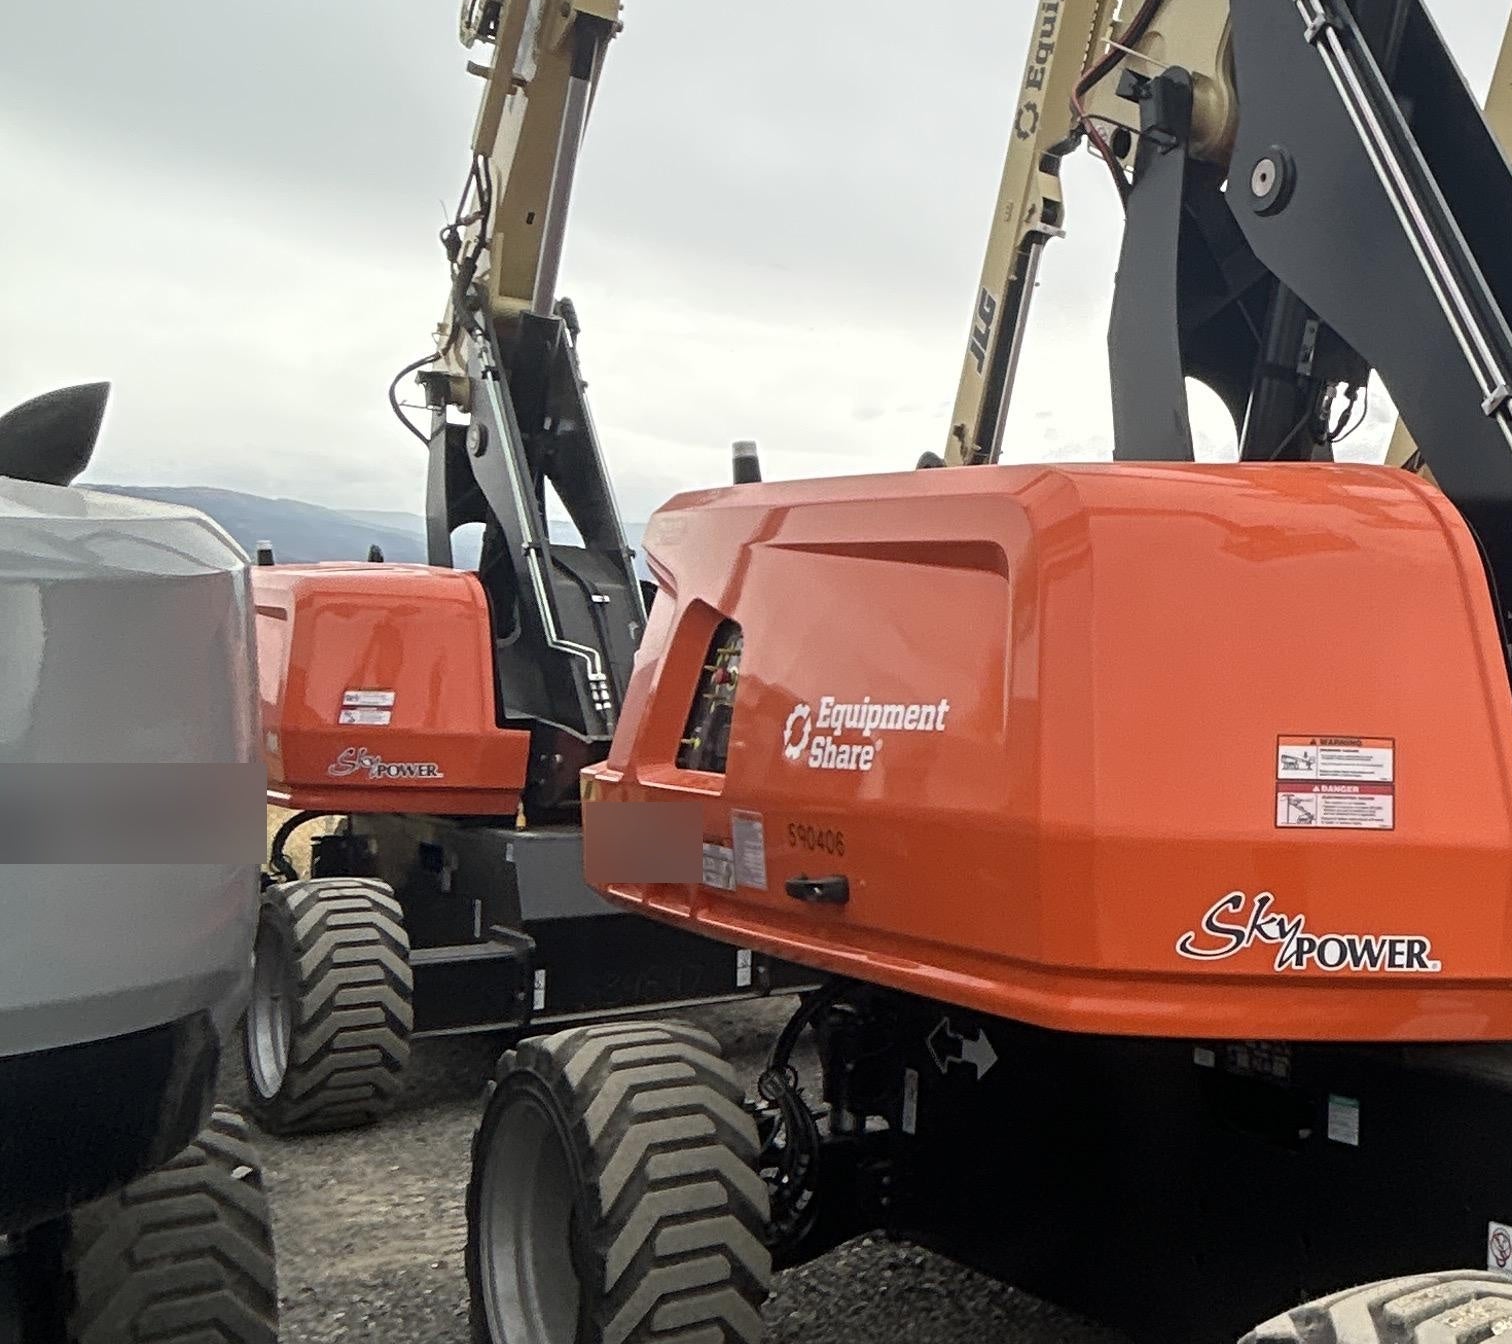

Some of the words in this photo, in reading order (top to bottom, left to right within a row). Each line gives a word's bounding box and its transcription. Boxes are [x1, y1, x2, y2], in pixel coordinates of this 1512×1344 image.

[970, 286, 997, 375] JLG
[816, 696, 950, 736] Equipment
[808, 736, 875, 771] Share
[1321, 785, 1360, 793] DANGER
